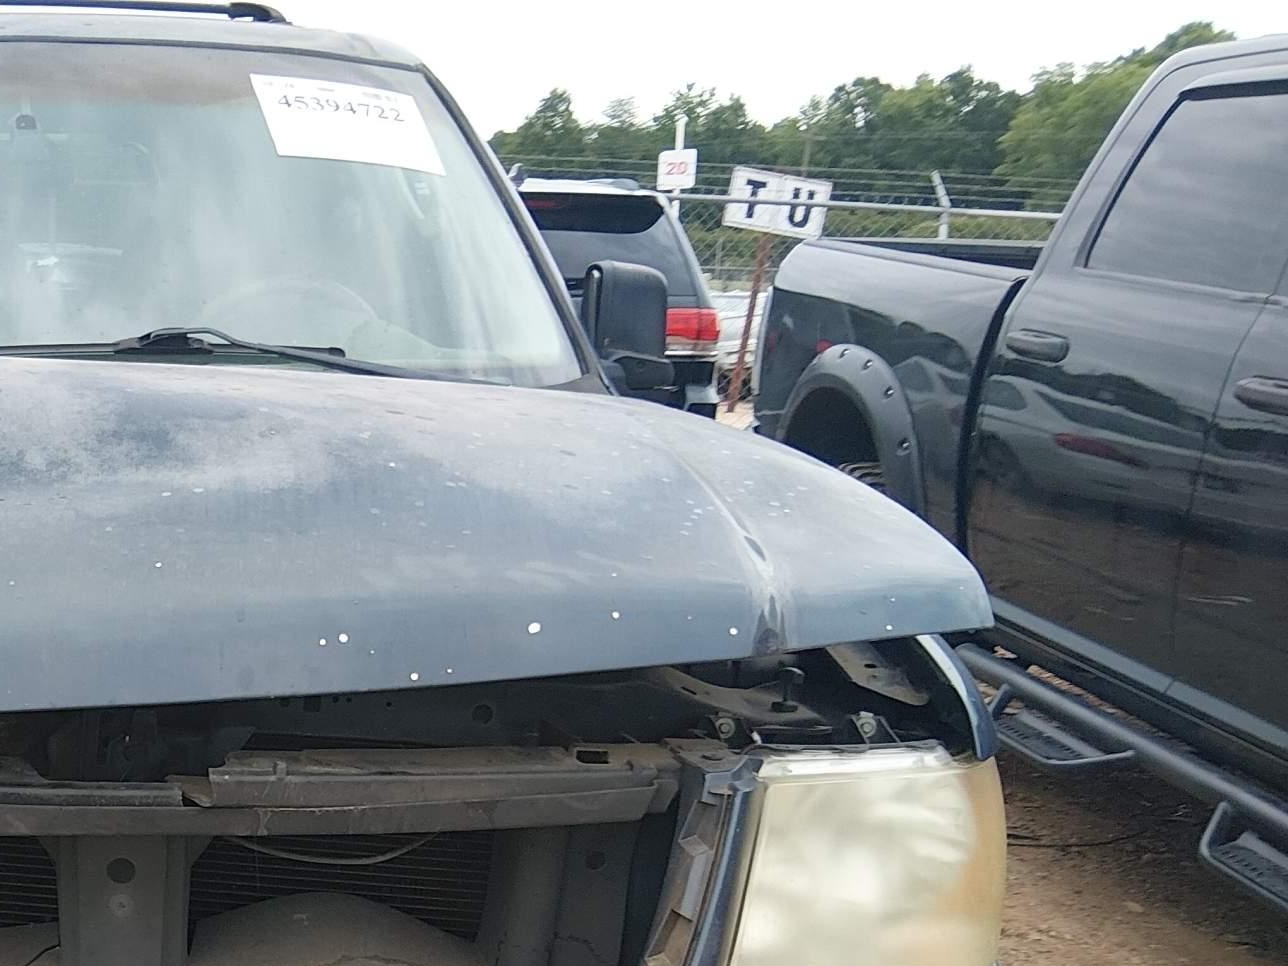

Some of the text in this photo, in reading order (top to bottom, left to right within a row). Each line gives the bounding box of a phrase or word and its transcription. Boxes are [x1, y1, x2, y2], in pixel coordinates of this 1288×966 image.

[277, 94, 406, 122] 45394722
[744, 178, 816, 229] T U
